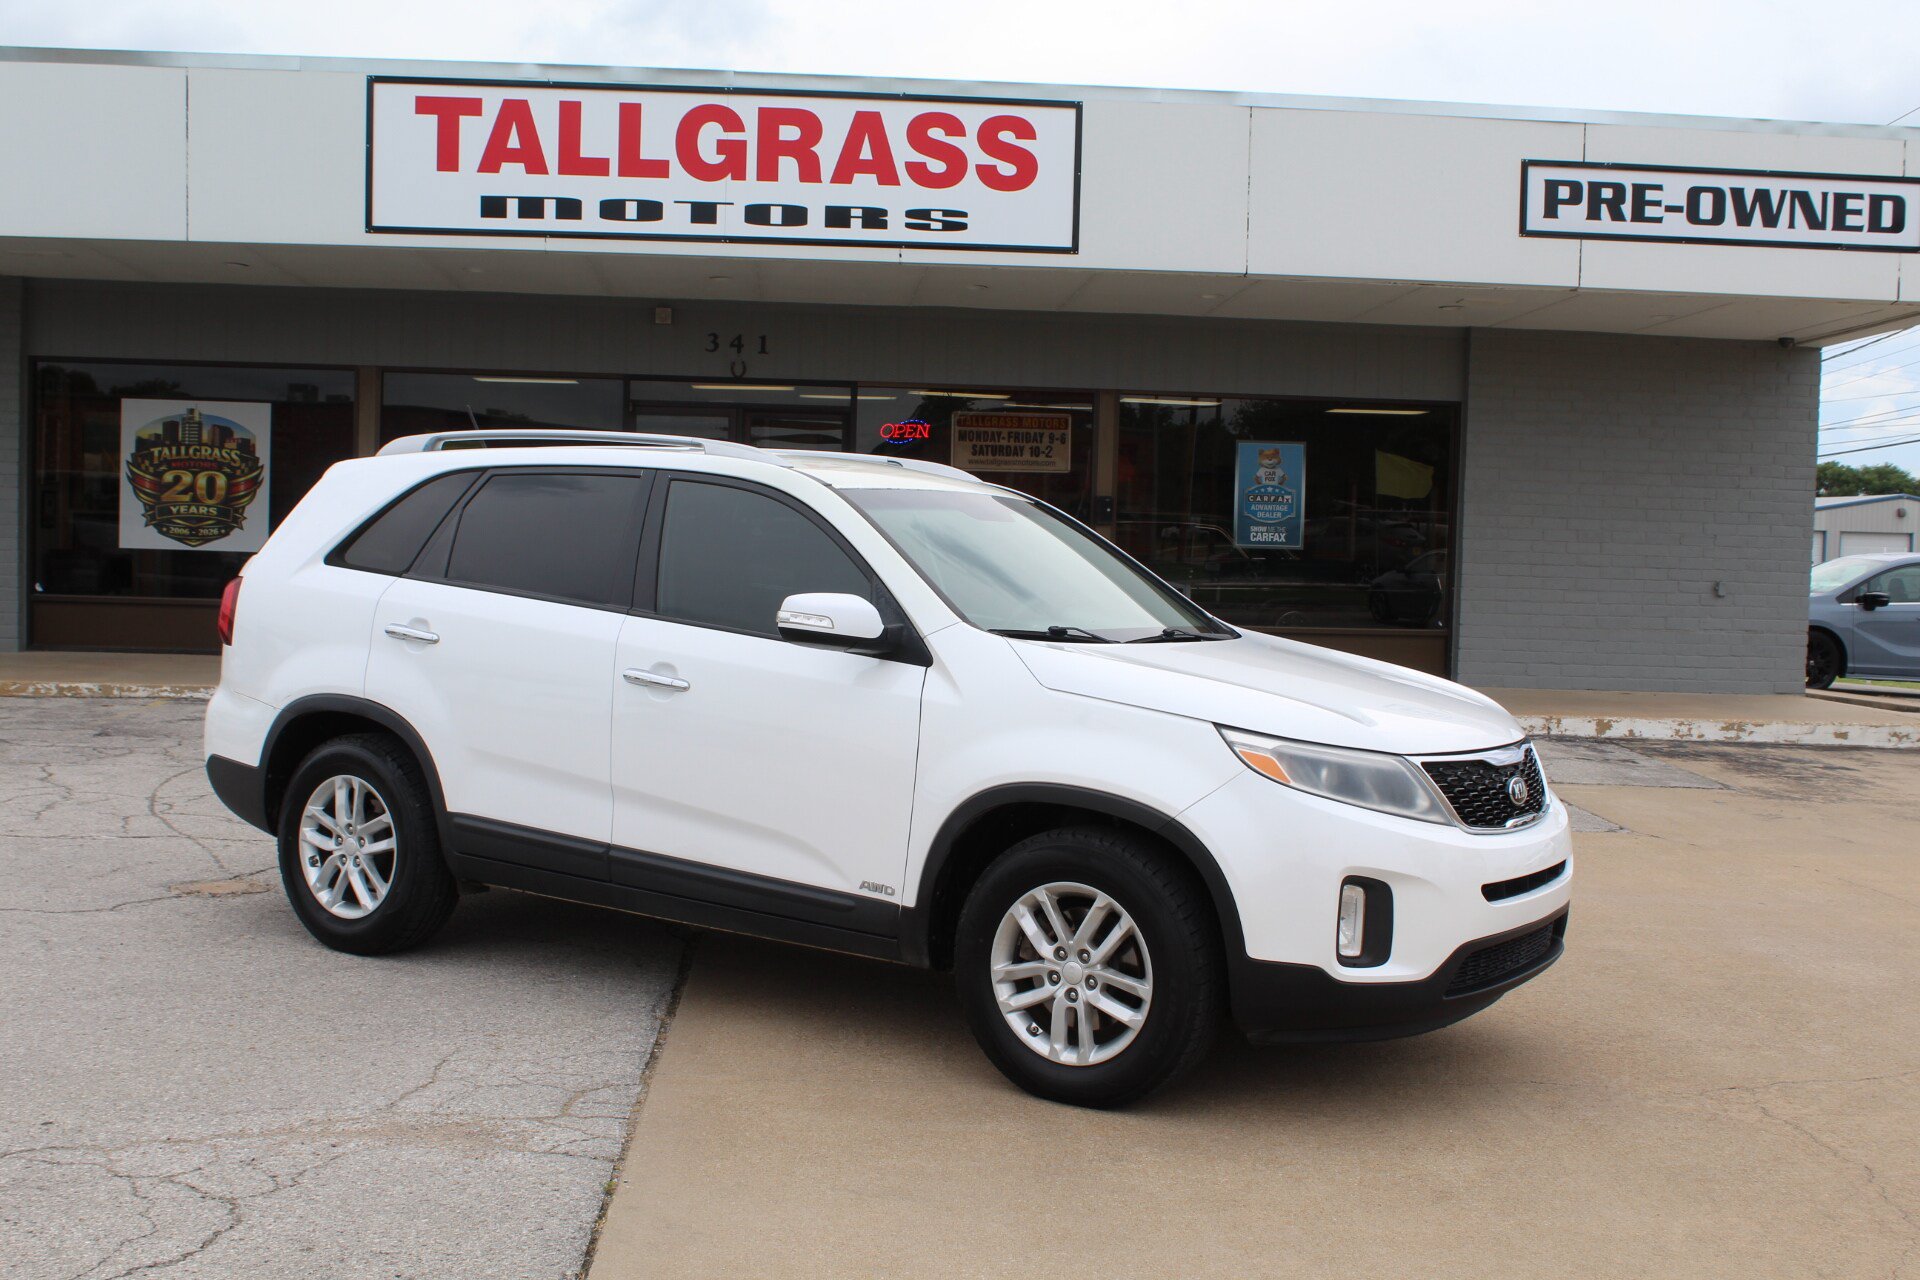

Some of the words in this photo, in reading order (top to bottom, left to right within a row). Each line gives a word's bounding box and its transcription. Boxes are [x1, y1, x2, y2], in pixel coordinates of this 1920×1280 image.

[415, 95, 1038, 192] TALLGRASS
[1542, 178, 1907, 234] PRE-OWNED
[705, 332, 769, 354] 341
[959, 415, 1018, 428] TALLGRASS
[1023, 417, 1067, 429] MOTORS
[880, 423, 931, 438] OPEN
[150, 445, 241, 466] TALLGRASS
[971, 444, 1025, 457] SATURDAY
[1029, 445, 1054, 458] 10-2
[171, 461, 218, 469] MOTORS
[160, 469, 228, 504] 20
[1248, 495, 1292, 503] CARFAX
[170, 505, 218, 515] YEARS
[169, 527, 190, 535] 2006
[198, 528, 219, 536] 2026
[1250, 525, 1267, 533] SHOW
[1250, 532, 1286, 542] CARFAX
[859, 880, 896, 896] AWD
